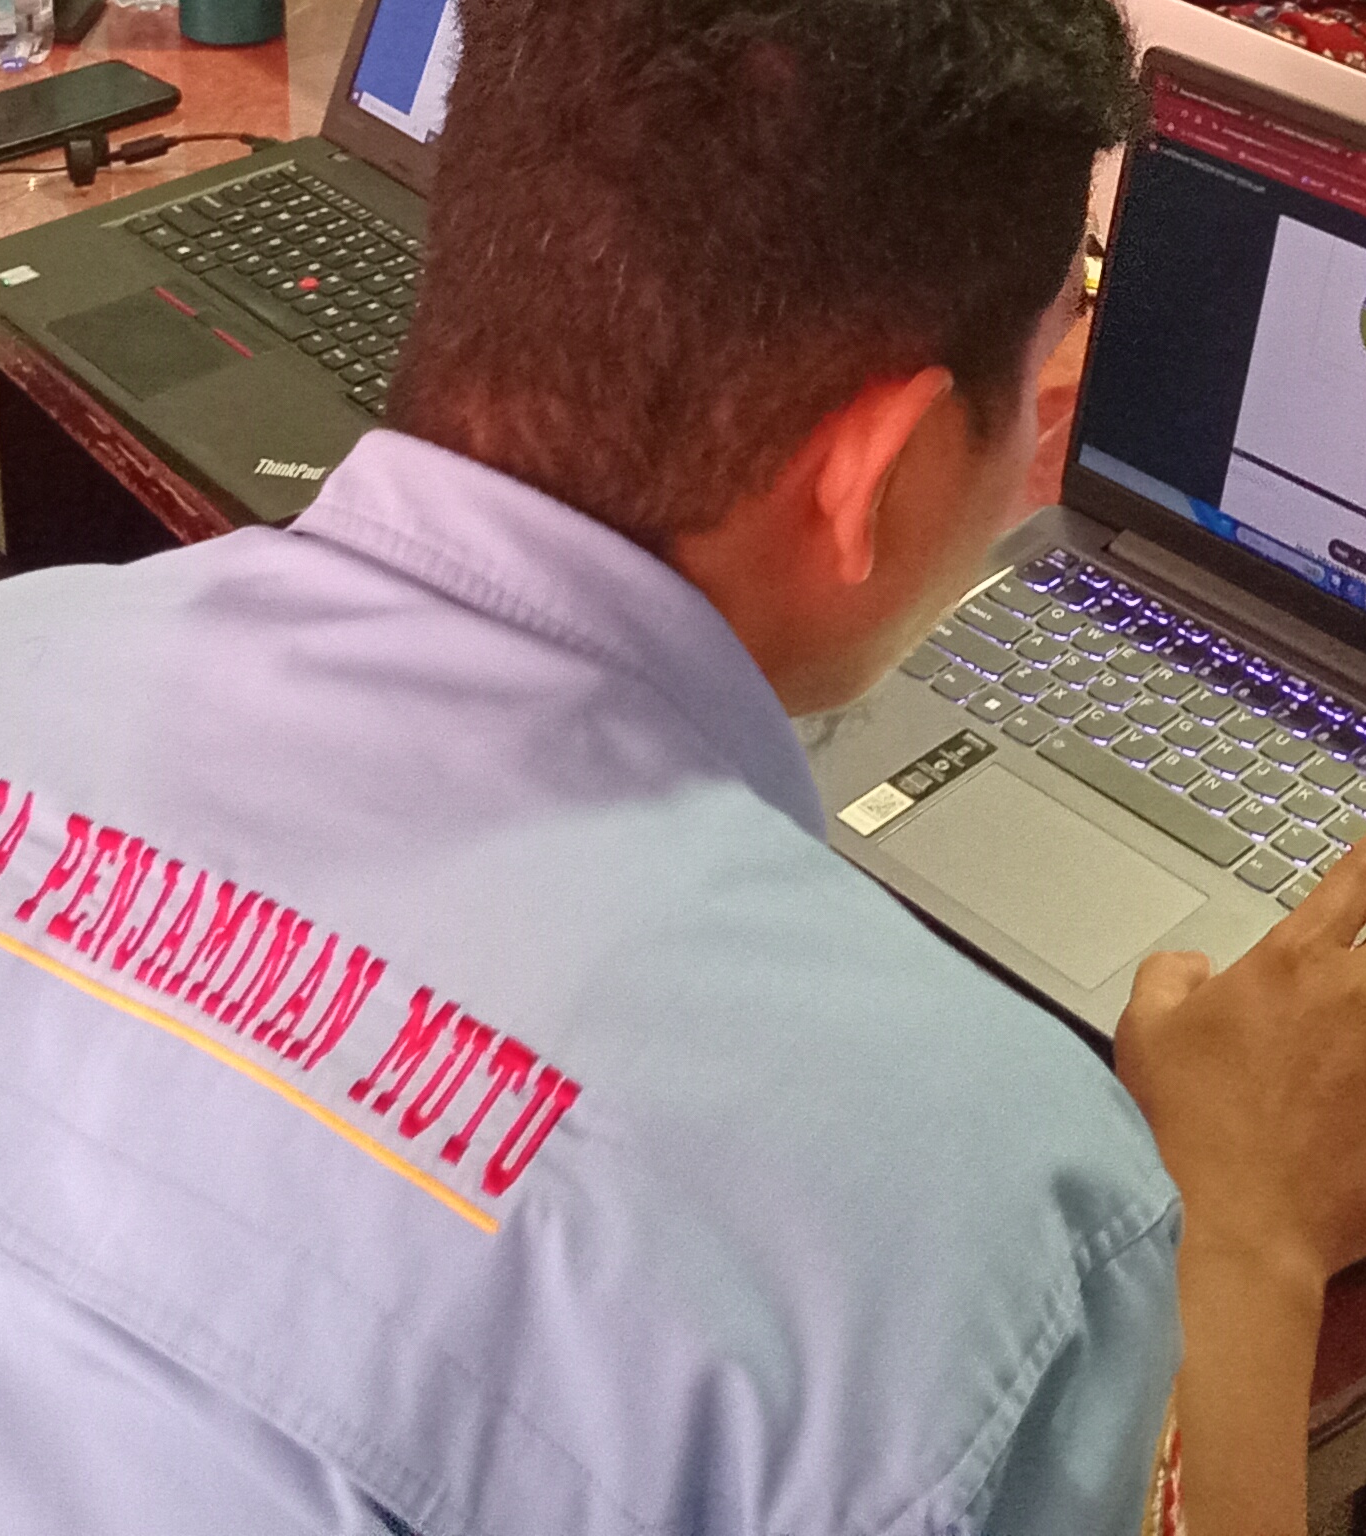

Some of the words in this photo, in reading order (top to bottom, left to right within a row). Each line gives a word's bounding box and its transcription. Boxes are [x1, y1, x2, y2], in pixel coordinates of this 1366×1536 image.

[254, 456, 328, 483] ThinkPad
[15, 813, 388, 1072] PENJAMINAN
[346, 985, 583, 1198] MUTU
